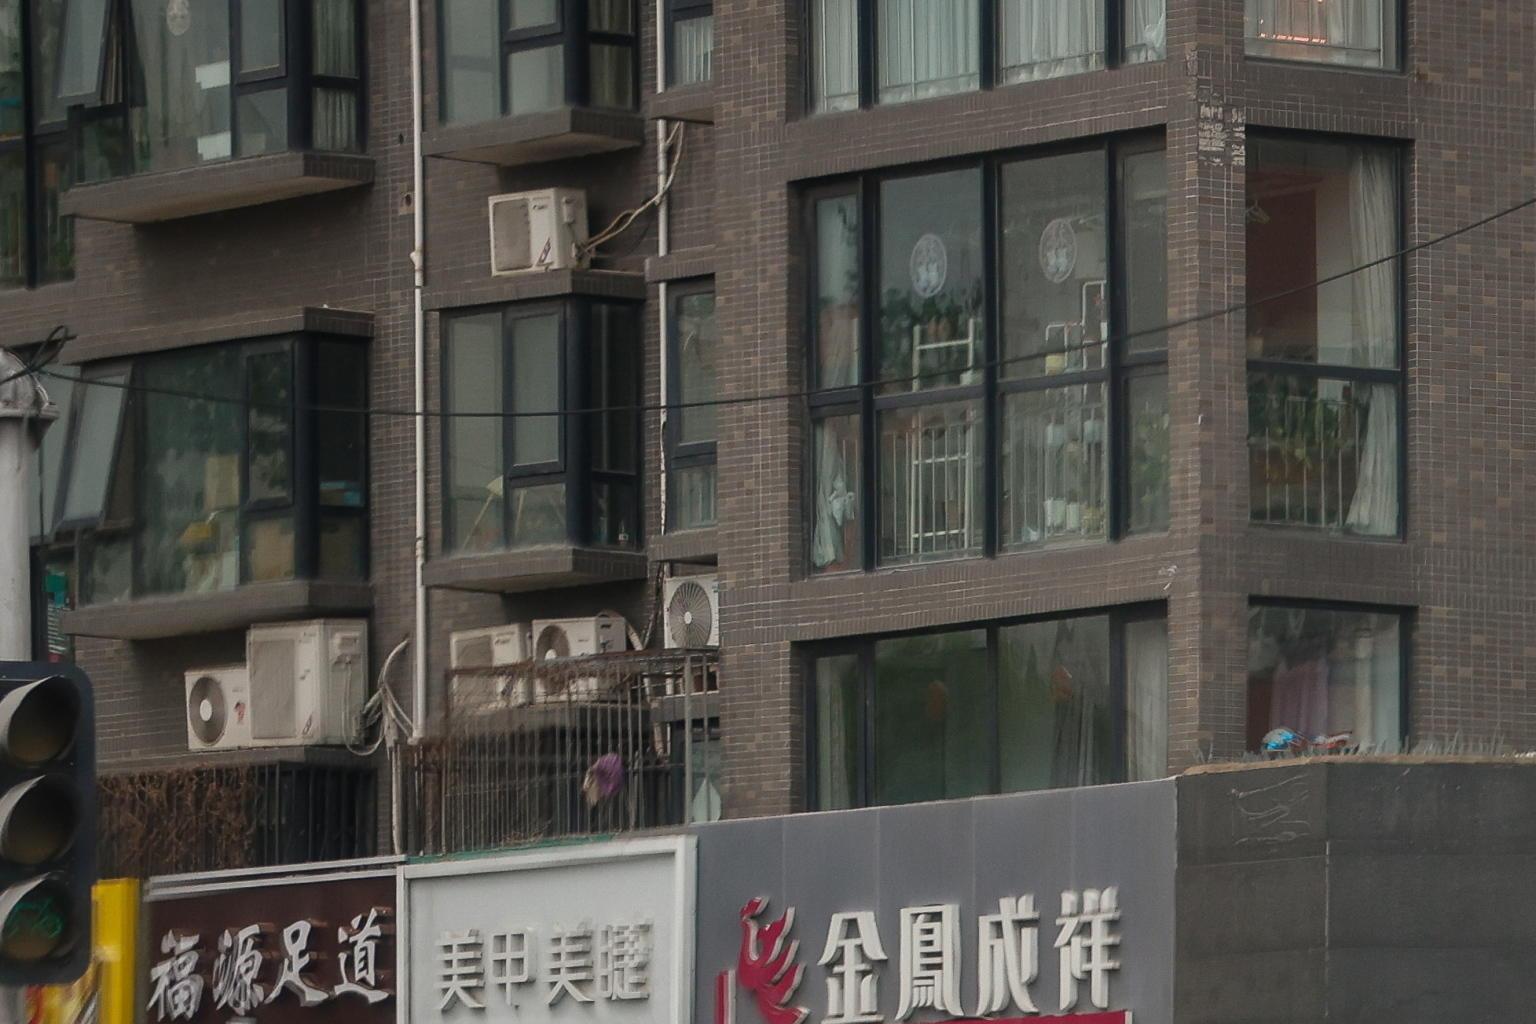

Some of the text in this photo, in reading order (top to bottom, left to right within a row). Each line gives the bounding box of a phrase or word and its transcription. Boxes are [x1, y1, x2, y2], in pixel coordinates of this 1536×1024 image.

[146, 906, 390, 1023] 福源足道
[434, 919, 652, 1012] 美甲美睫
